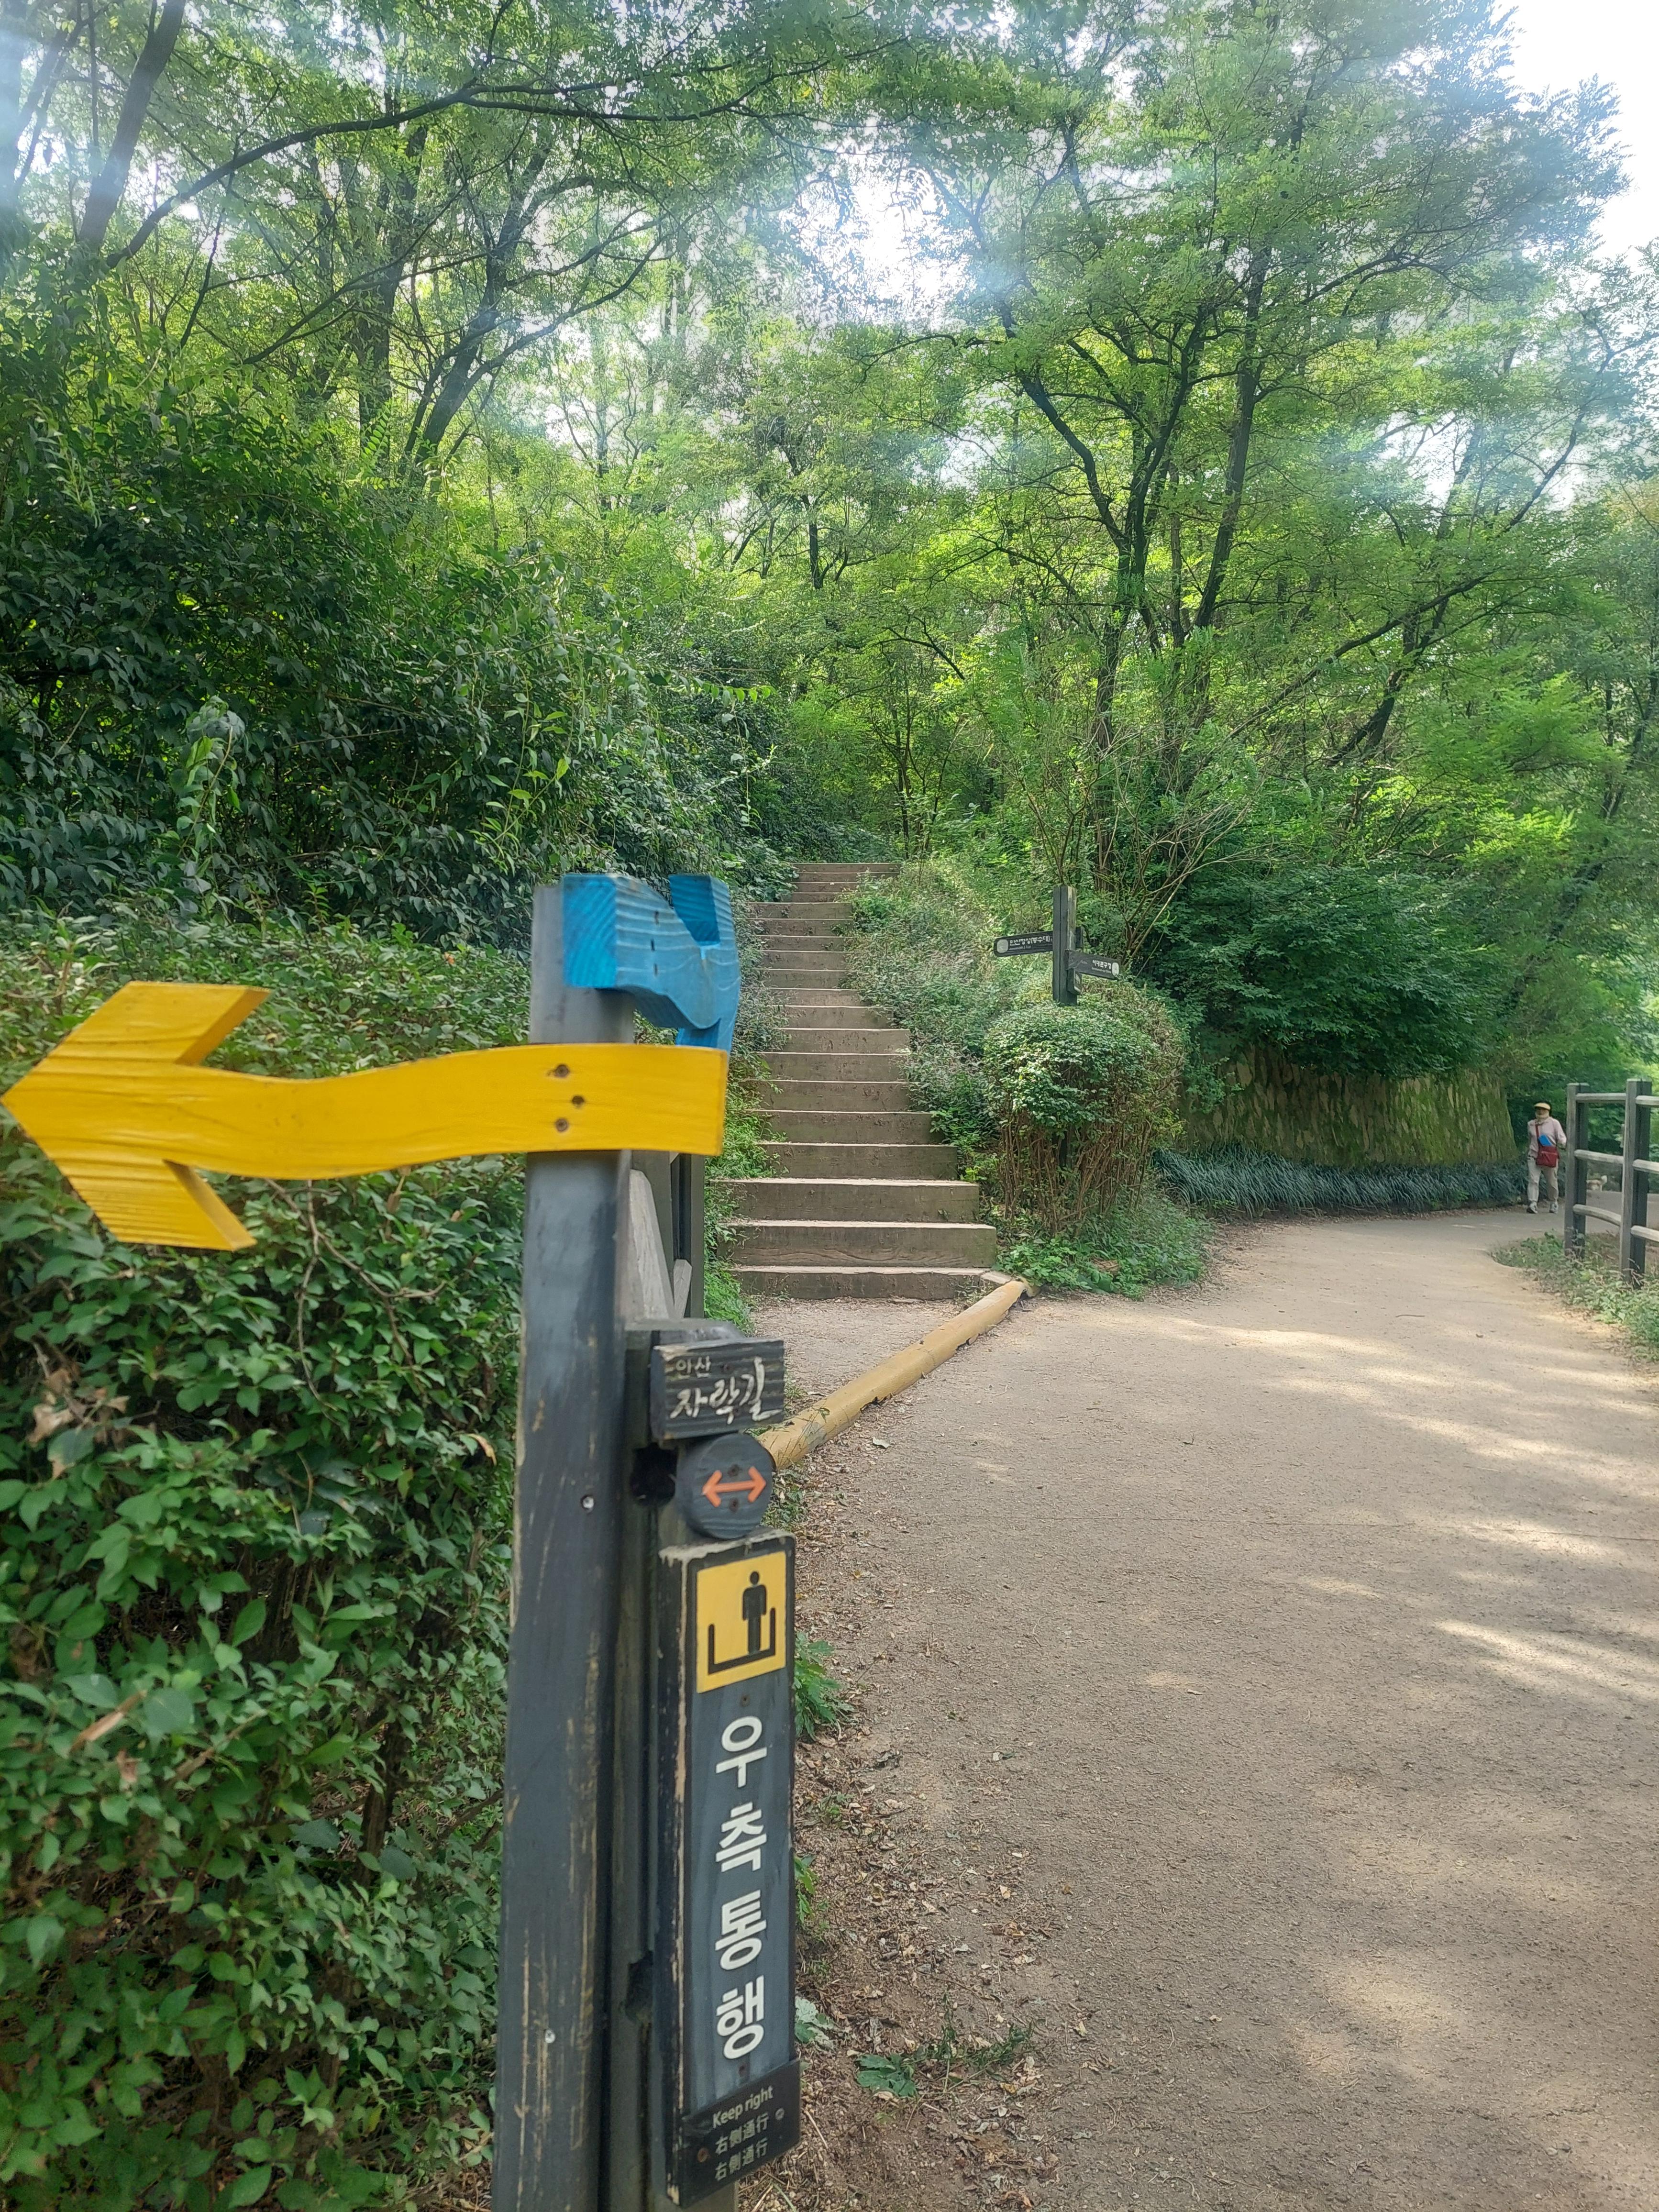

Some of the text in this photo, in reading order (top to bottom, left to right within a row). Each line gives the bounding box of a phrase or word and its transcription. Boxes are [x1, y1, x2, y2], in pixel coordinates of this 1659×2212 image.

[670, 1356, 784, 1425] 자락길
[675, 1355, 711, 1379] 안산
[715, 1715, 767, 2059] 우측통행
[712, 2085, 774, 2129] Keep right
